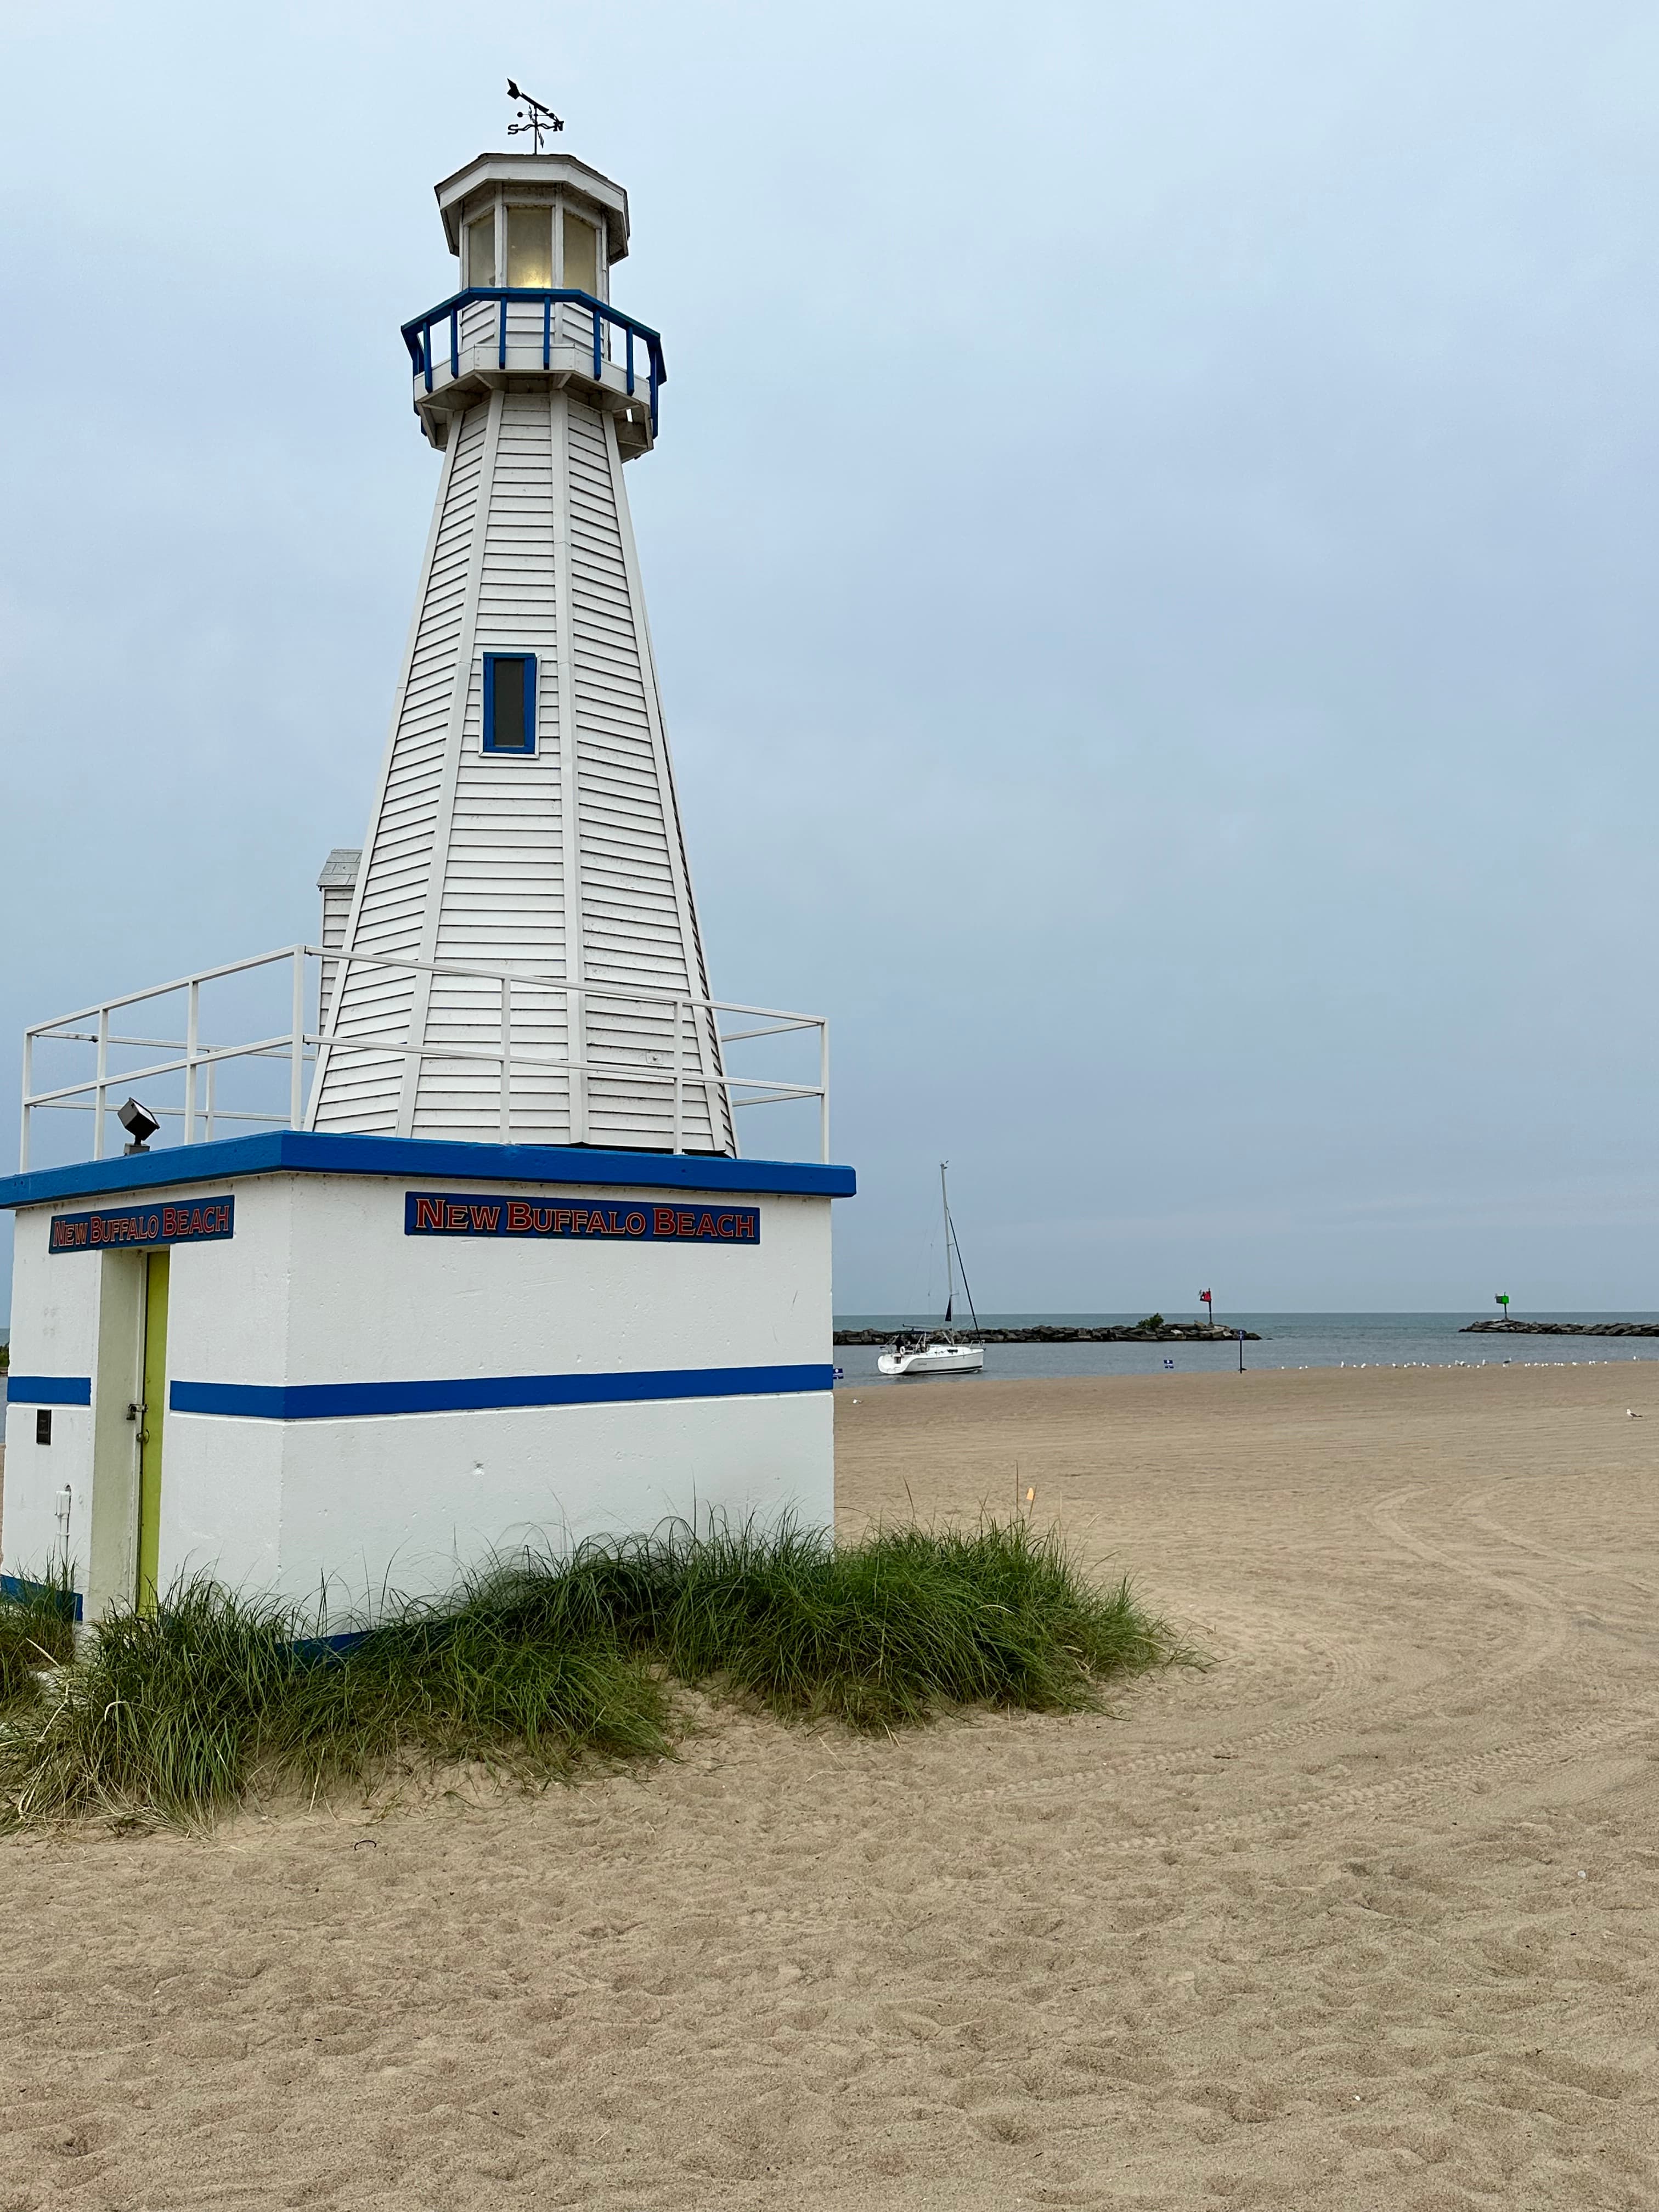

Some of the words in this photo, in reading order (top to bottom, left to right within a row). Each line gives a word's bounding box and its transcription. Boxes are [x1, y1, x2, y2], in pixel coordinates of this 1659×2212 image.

[507, 124, 518, 135] S
[553, 121, 564, 132] N
[53, 1220, 88, 1246] NEW
[90, 1215, 159, 1243] BUFFALO
[162, 1205, 229, 1236] BEACH
[416, 1198, 500, 1230] NEW
[506, 1201, 646, 1234] BUFFALO
[653, 1208, 754, 1238] BEACH
